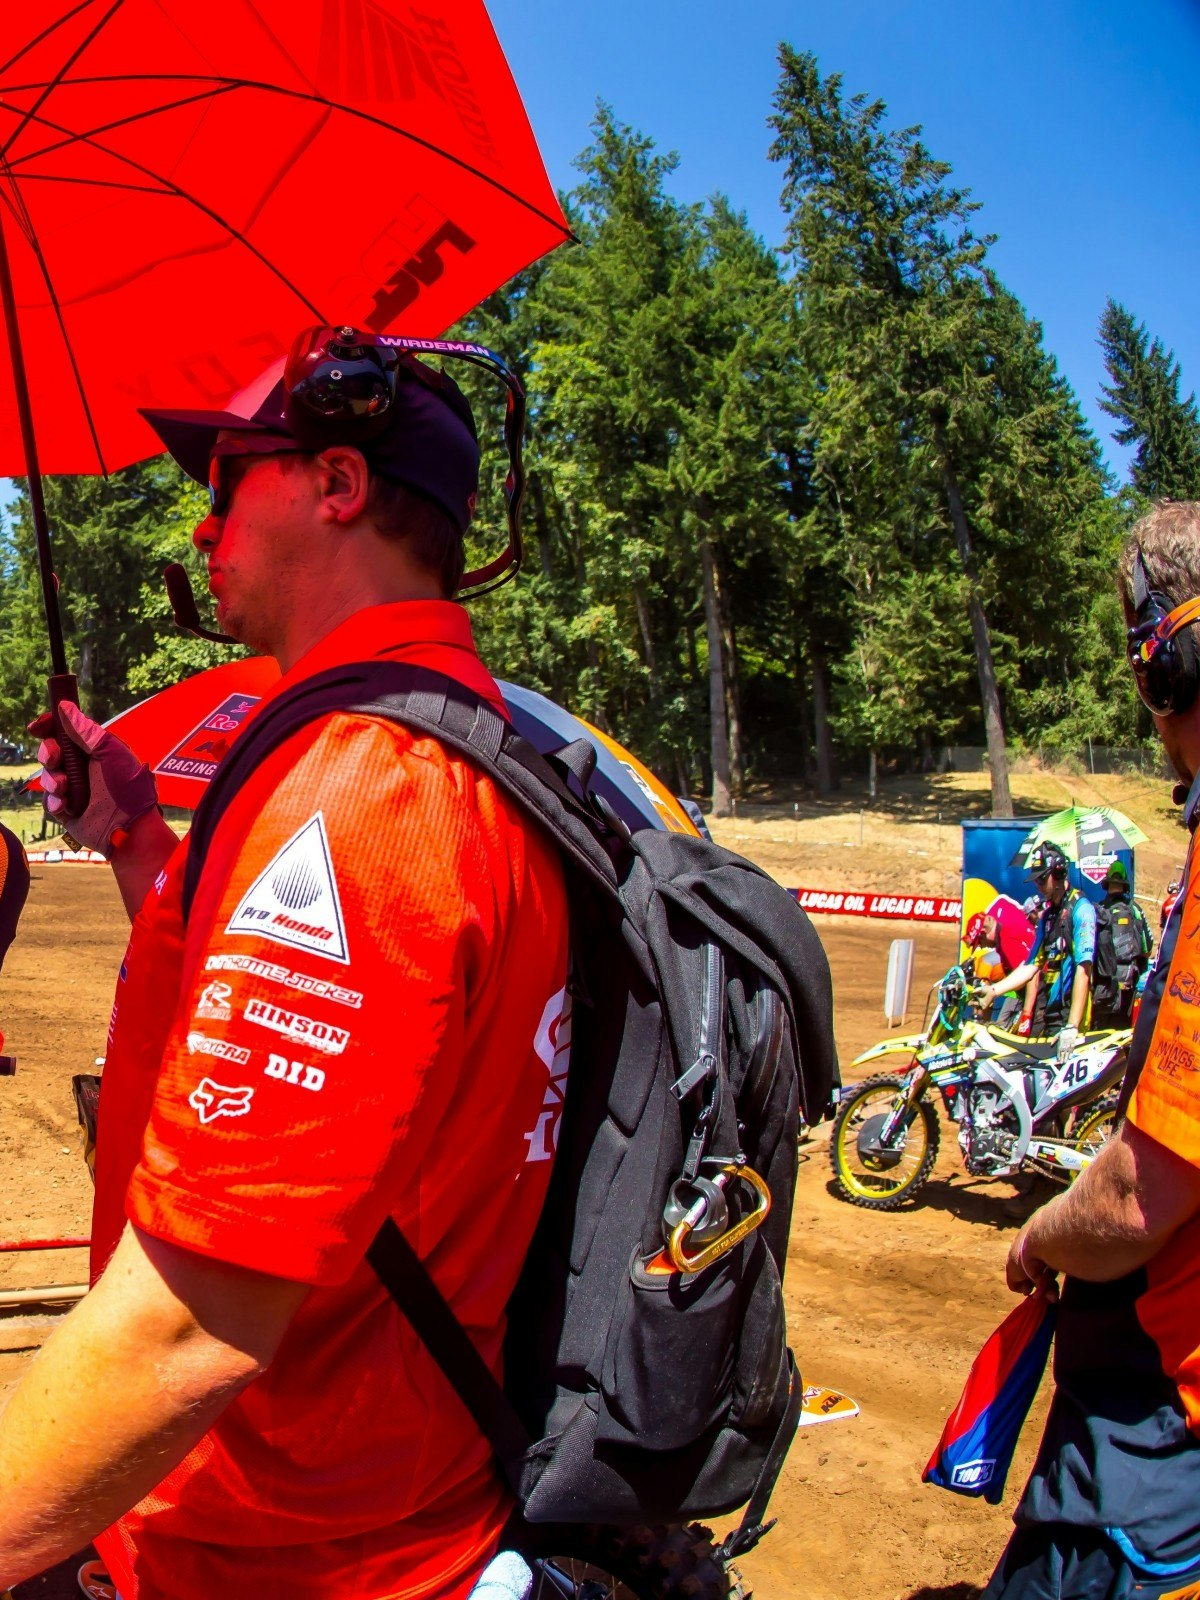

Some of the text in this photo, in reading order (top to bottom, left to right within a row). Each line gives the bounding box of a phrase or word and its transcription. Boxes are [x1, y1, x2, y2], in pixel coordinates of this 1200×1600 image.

[379, 337, 490, 357] WIRDEMAN
[205, 713, 239, 731] Re
[163, 758, 218, 776] RACING
[800, 892, 844, 910] LUCAS
[844, 896, 866, 912] OIL
[870, 897, 913, 915] LUCAS
[914, 899, 935, 916] OIL
[241, 906, 271, 920] Pro
[271, 913, 335, 941] Honda
[250, 1001, 348, 1047] HINSON
[1159, 1041, 1195, 1068] WINGS
[1062, 1059, 1089, 1087] 46
[1157, 1057, 1179, 1077] LIFE
[955, 1466, 991, 1484] 100%
